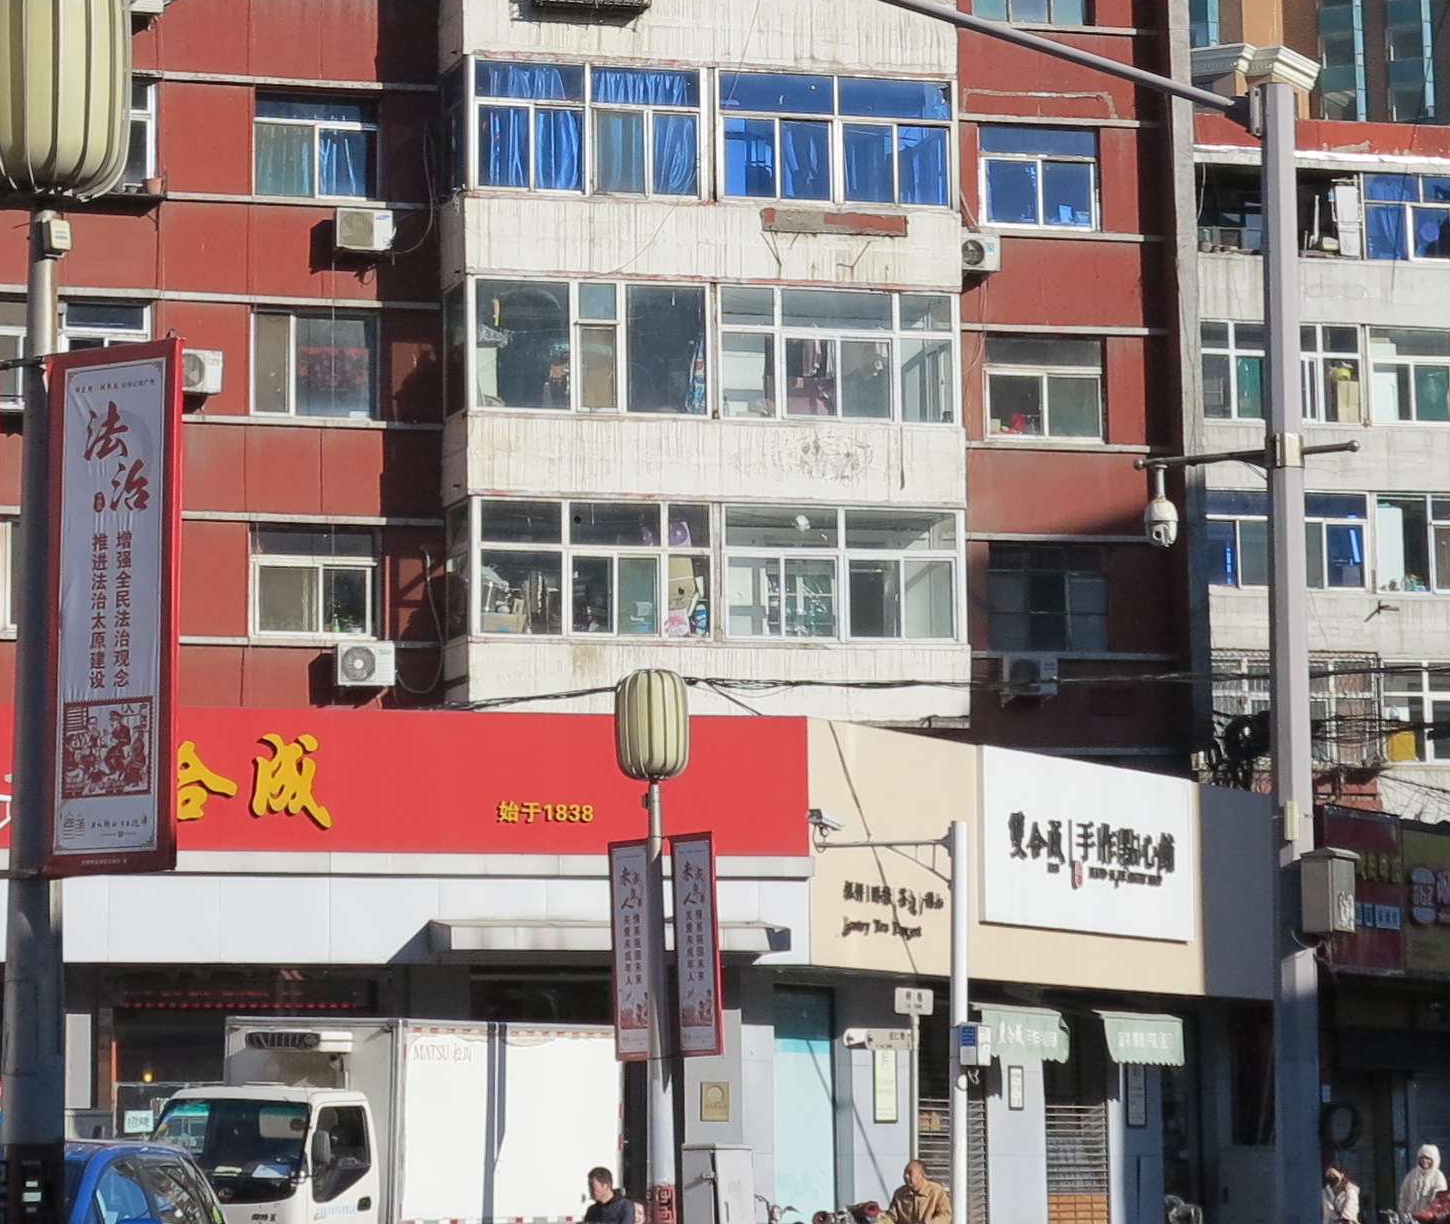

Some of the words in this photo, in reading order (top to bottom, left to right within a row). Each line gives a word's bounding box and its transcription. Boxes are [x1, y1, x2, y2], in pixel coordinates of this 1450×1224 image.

[84, 400, 150, 511] 法治
[89, 533, 109, 689] 推进法治太原建设
[113, 530, 132, 688] 增强全民法治观念
[498, 800, 595, 823] 始于1838
[413, 1044, 450, 1061] MATSU
